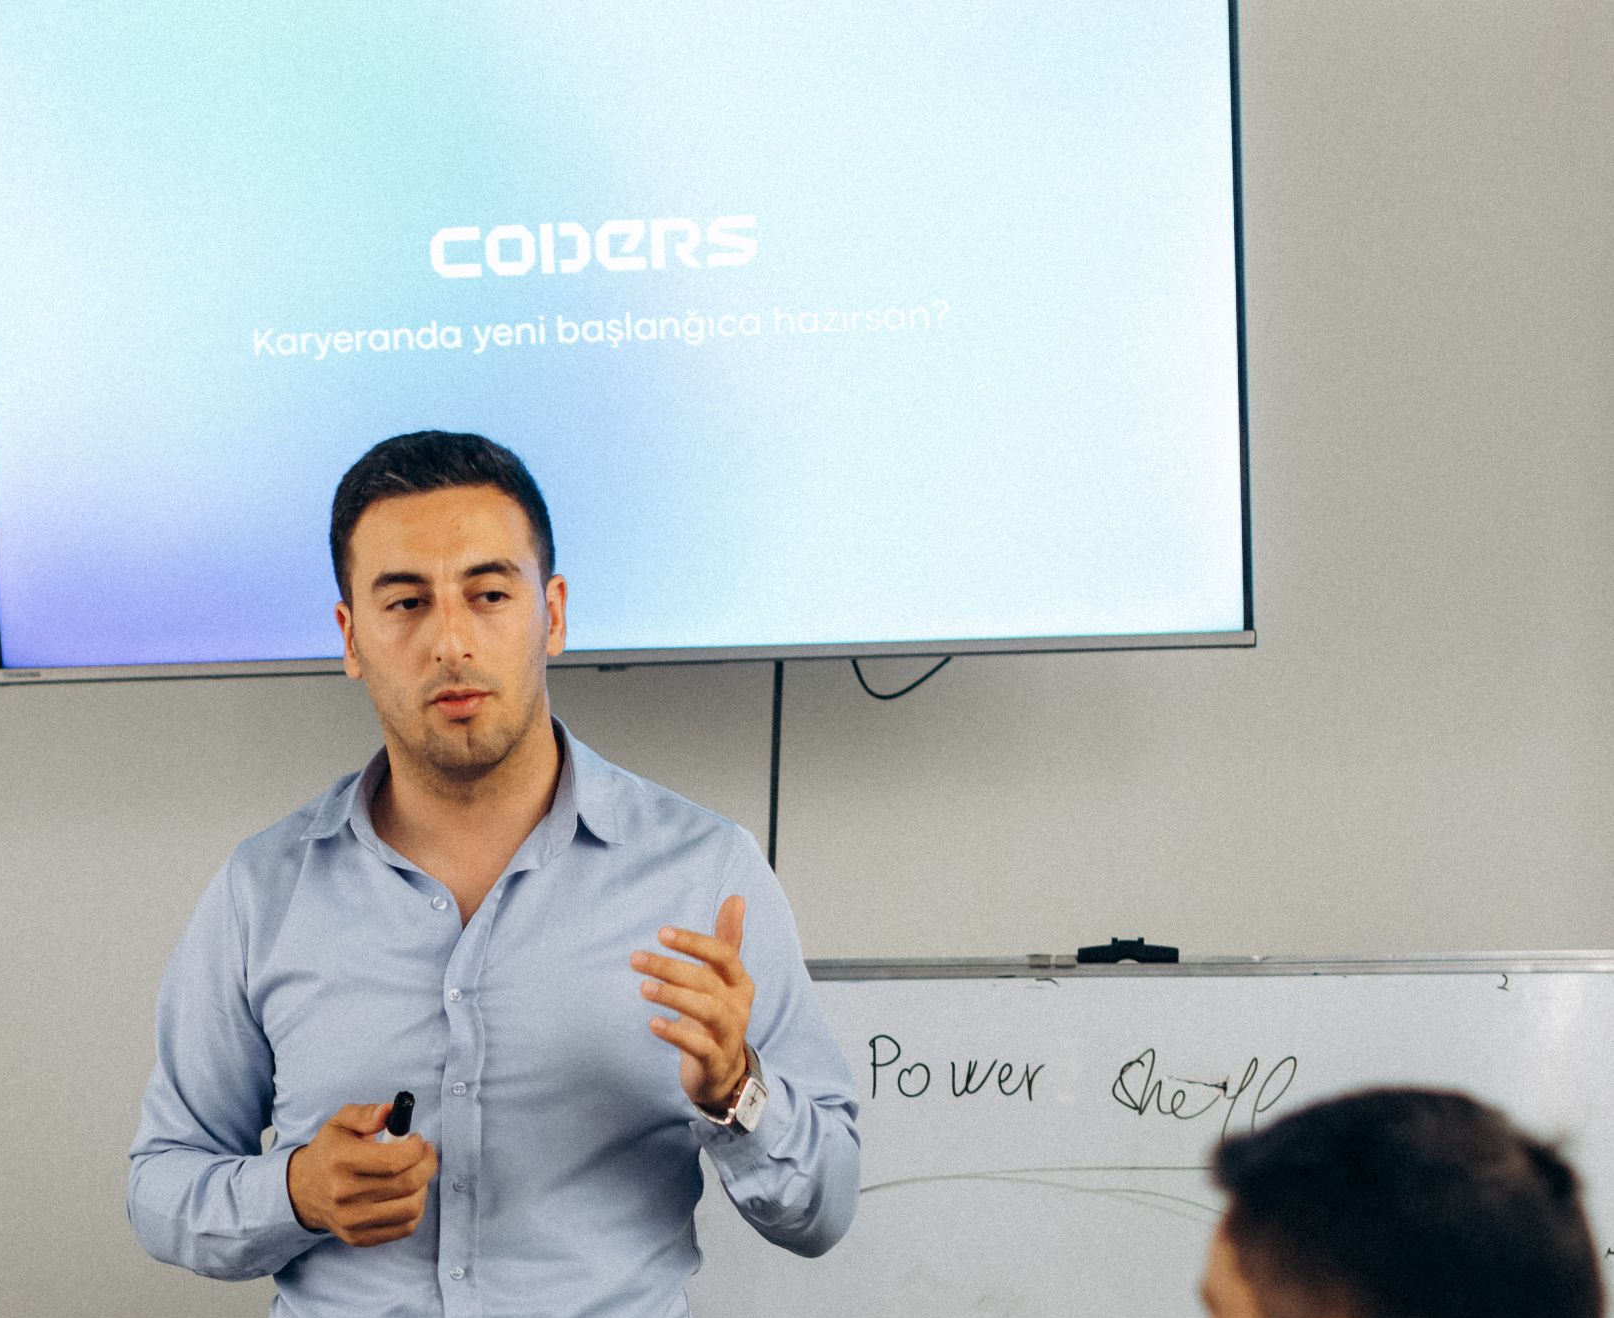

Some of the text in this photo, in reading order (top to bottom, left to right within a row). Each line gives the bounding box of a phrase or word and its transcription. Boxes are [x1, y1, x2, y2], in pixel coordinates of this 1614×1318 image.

[429, 214, 759, 279] CODERS
[252, 299, 950, 360] Karyeranda yeni başlanğıca hazırsan?
[868, 1034, 1046, 1102] Power
